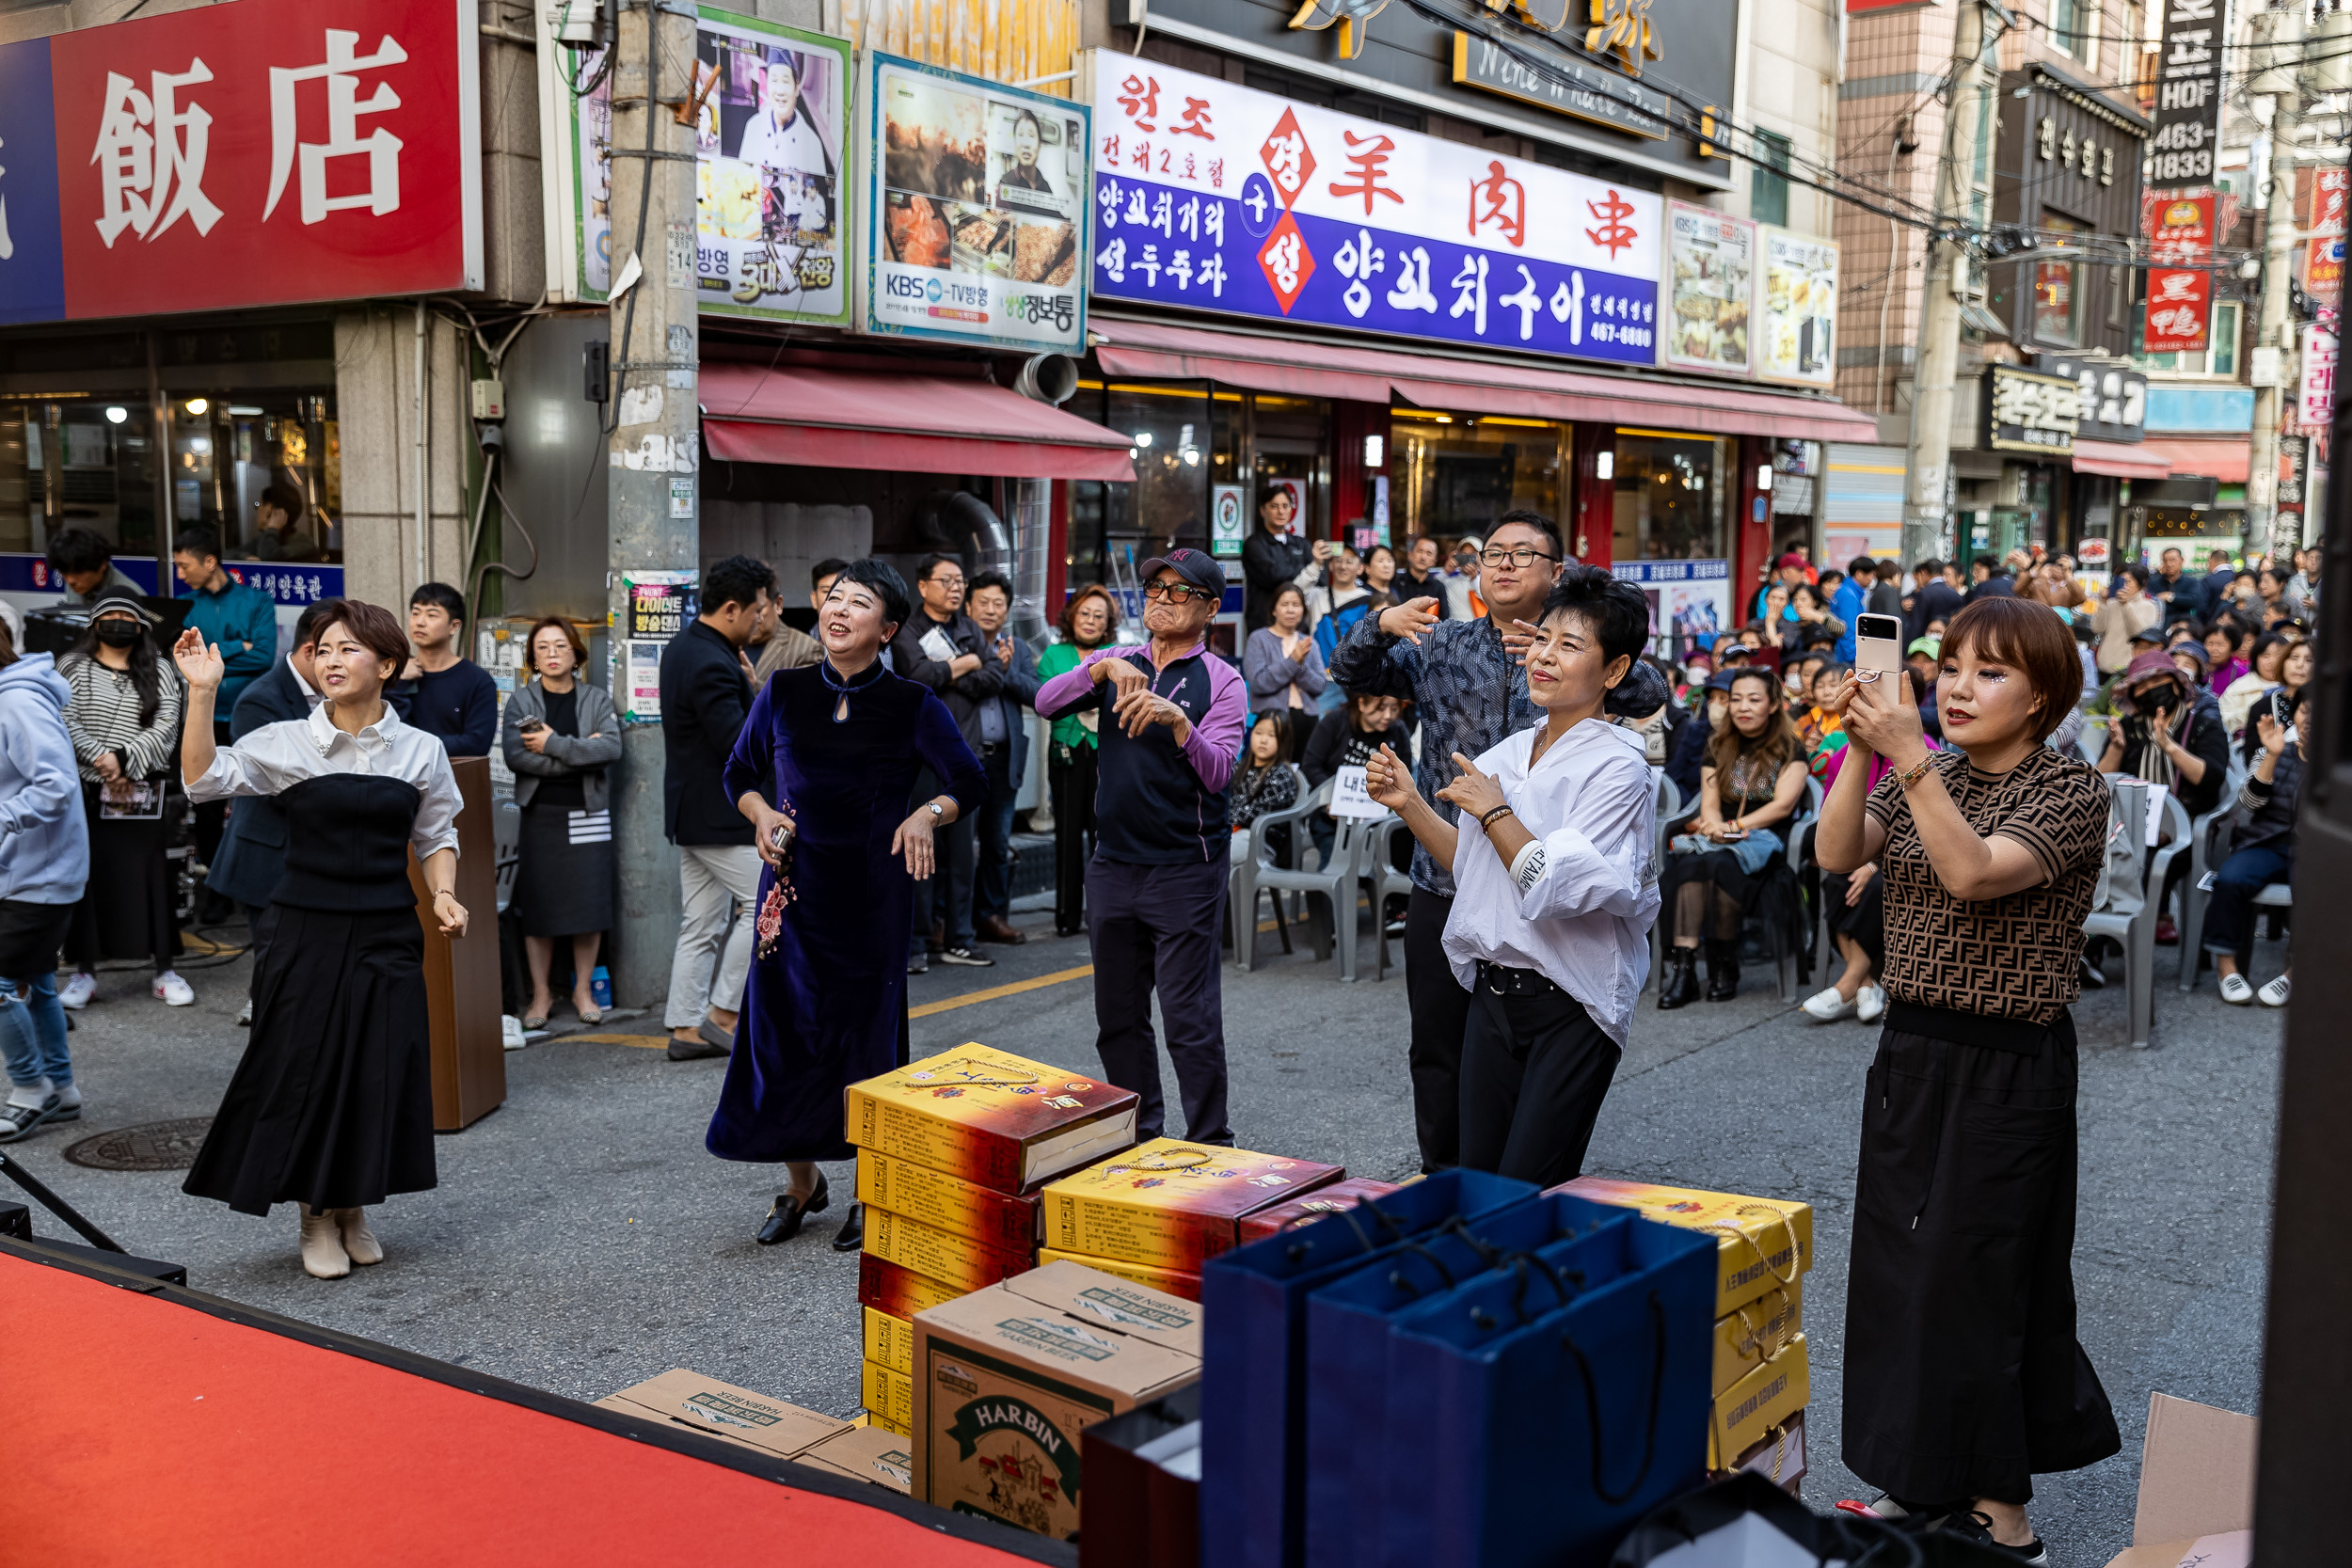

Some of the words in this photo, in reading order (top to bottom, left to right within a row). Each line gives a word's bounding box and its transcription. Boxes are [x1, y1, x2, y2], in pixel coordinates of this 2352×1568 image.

[1117, 74, 1216, 141] 원조
[2162, 78, 2217, 110] HOF
[90, 27, 408, 249] 飯店
[2154, 120, 2216, 150] 463-
[1268, 130, 1305, 193] 경
[2153, 149, 2214, 181] 1833
[1327, 129, 1639, 261] 羊肉串
[1097, 178, 1226, 248] 양꼬치거리
[697, 247, 730, 276] 방영
[1264, 231, 1302, 294] 성
[886, 274, 926, 299] KBS
[1332, 228, 1585, 346] 양꼬치구이
[1006, 293, 1074, 334] 생생정보통
[635, 596, 682, 613] 다이어트
[635, 614, 681, 632] 방송댄스
[1041, 1095, 1084, 1110] 酒
[1246, 1173, 1292, 1188] 酒
[721, 1391, 747, 1403] BEER
[739, 1400, 783, 1415] HARBIN
[975, 1404, 1061, 1453] HARBIN
